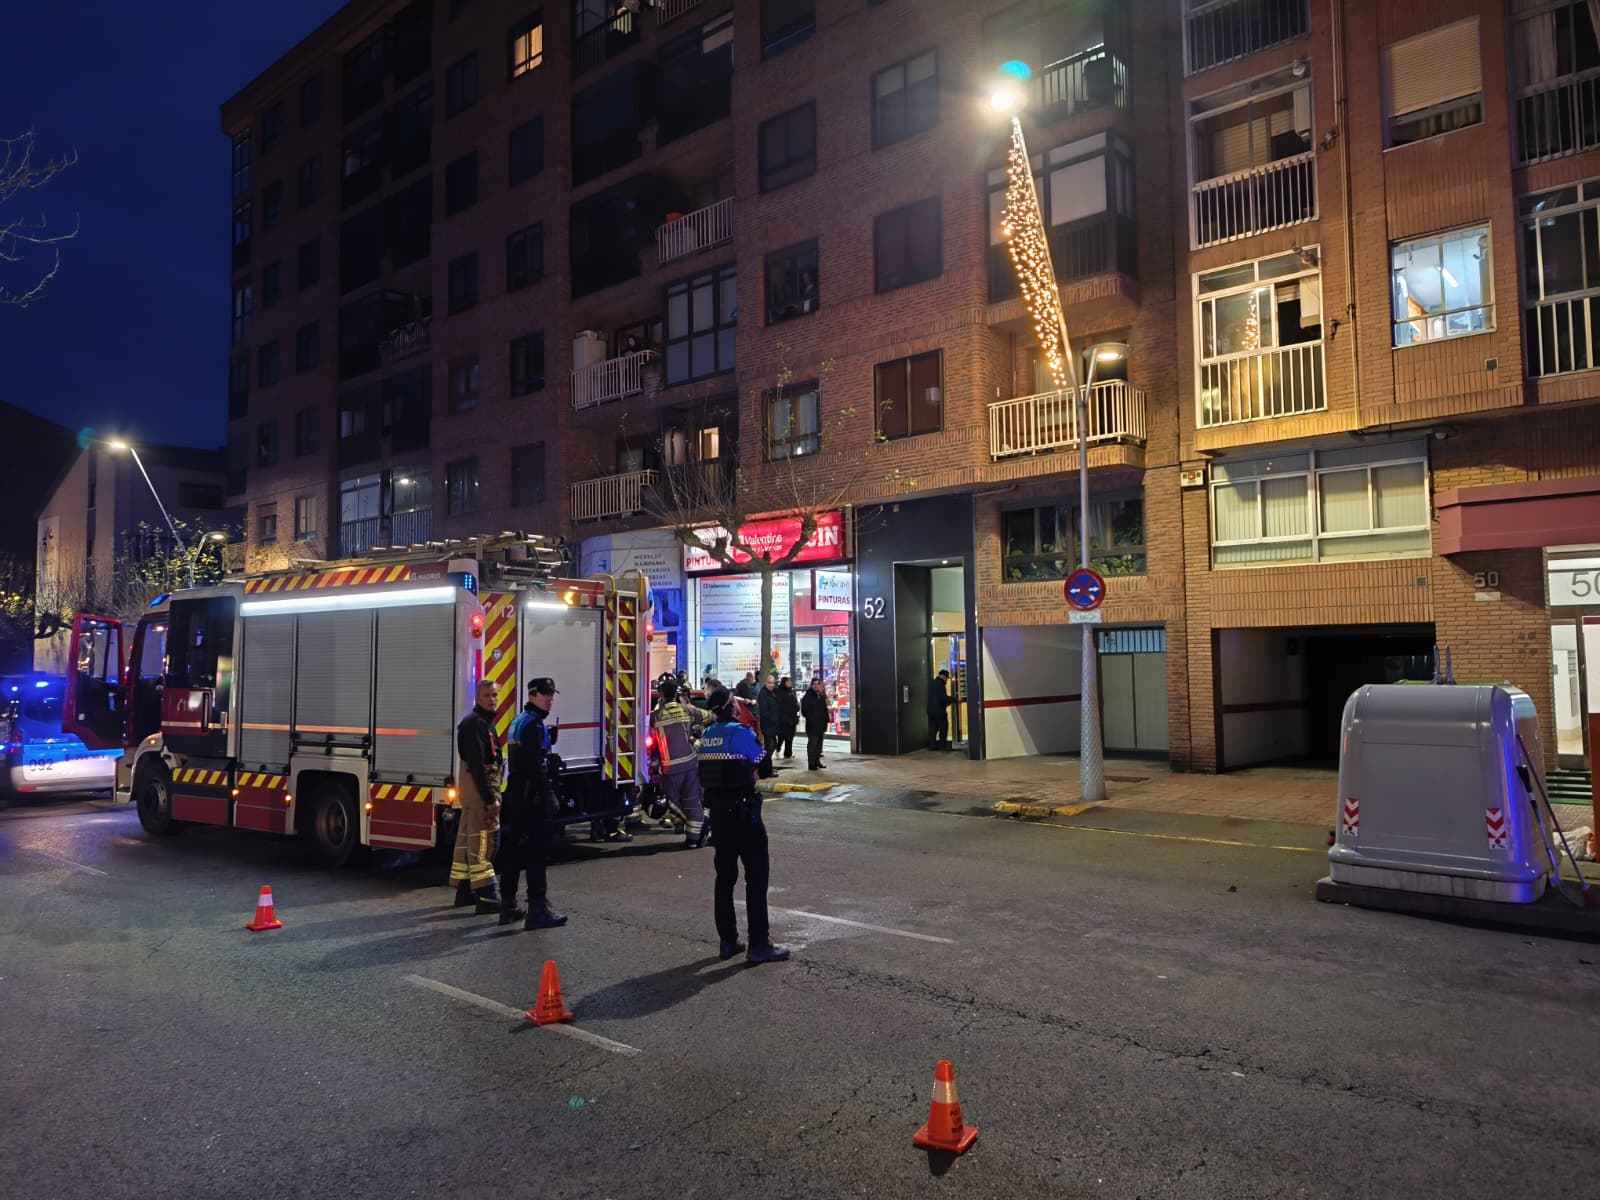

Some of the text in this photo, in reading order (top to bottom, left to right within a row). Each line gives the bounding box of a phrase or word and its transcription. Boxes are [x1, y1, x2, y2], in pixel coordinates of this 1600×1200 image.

[744, 533, 782, 546] Valentine
[1474, 572, 1499, 588] 50
[818, 595, 850, 604] PINTURAS
[864, 597, 885, 619] 52
[29, 758, 54, 771] 092
